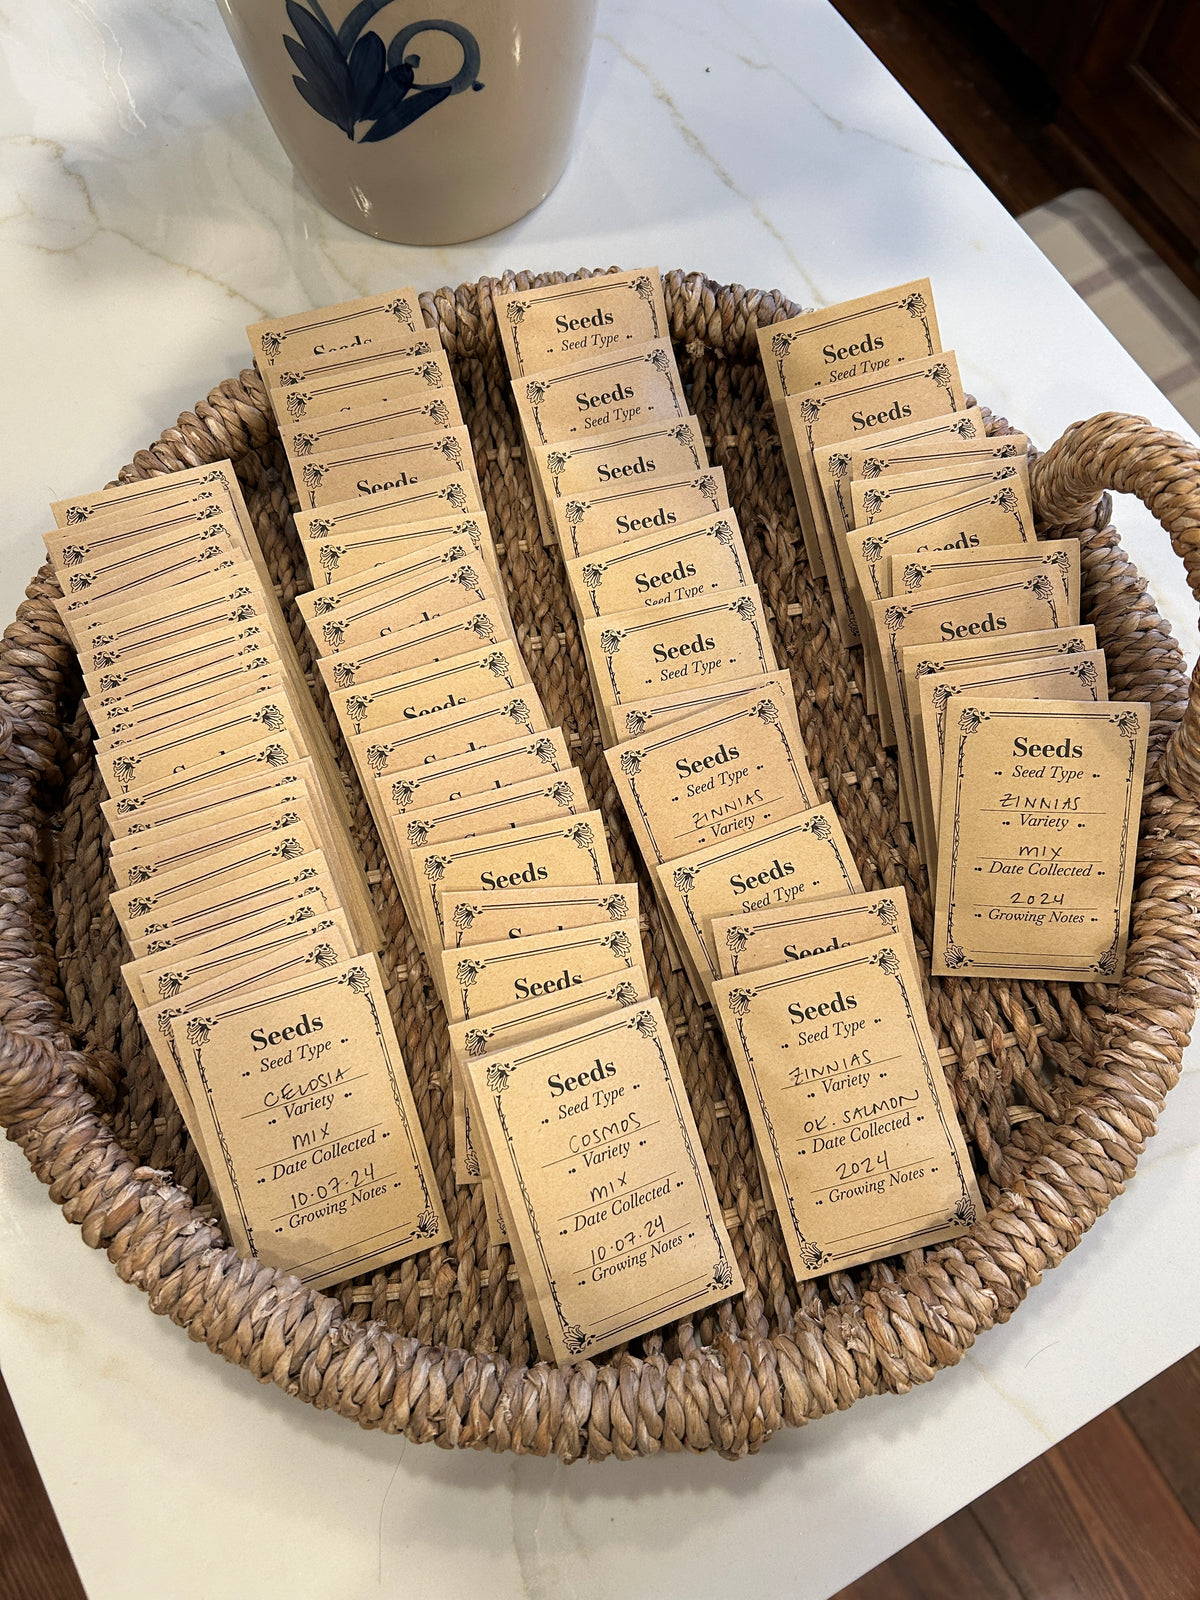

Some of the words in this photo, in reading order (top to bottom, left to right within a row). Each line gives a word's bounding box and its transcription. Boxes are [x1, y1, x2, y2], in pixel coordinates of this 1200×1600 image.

[556, 308, 614, 333] Seeds
[561, 336, 587, 351] Seed
[590, 333, 619, 348] Type
[822, 333, 884, 365] Seeds
[829, 364, 857, 383] Seed
[860, 358, 890, 374] Type
[576, 383, 634, 411] Seeds
[584, 413, 610, 429] Seed
[612, 405, 641, 423] Type
[852, 401, 912, 431] Seeds
[597, 456, 656, 482] Seeds
[616, 508, 676, 534] Seeds
[917, 531, 980, 553] eds
[635, 561, 696, 593] Seeds
[675, 584, 704, 600] Type
[940, 612, 1007, 641] Seeds
[653, 634, 716, 663] Seeds
[660, 664, 688, 681] Seed
[692, 657, 722, 675] Type
[675, 744, 740, 779] Seeds
[1012, 736, 1083, 758] Seeds
[686, 777, 715, 797] Seed
[718, 767, 749, 787] Type
[1012, 765, 1046, 778] Seed
[1050, 766, 1084, 783] Type
[692, 789, 764, 829] ZINNIAS
[1000, 793, 1081, 811] ZINNIAS
[710, 815, 755, 837] Variety
[1020, 814, 1069, 831] Variety
[480, 862, 548, 890] Seeds
[730, 859, 795, 895] Seeds
[988, 861, 1024, 875] Date
[1028, 863, 1093, 877] Collected
[742, 893, 771, 913] Seed
[773, 883, 805, 902] Type
[1010, 892, 1064, 905] 2024
[988, 908, 1046, 925] Growing
[1048, 911, 1085, 924] Notes
[514, 970, 583, 999] Seeds
[788, 991, 857, 1025] Seeds
[250, 1013, 324, 1052] Seeds
[798, 1026, 829, 1046] Seed
[833, 1018, 866, 1039] Type
[260, 1051, 293, 1073] Seed
[297, 1040, 332, 1062] Type
[788, 1049, 872, 1085] ZINNIAS
[263, 1067, 351, 1107] CELOSIA
[547, 1059, 617, 1098] Seeds
[821, 1070, 870, 1094] Variety
[284, 1092, 335, 1119] Variety
[558, 1101, 589, 1120] Seed
[592, 1085, 625, 1108] Type
[843, 1089, 919, 1124] SALMON
[569, 1112, 641, 1153] COSMOS
[812, 1134, 846, 1153] Date
[850, 1112, 911, 1143] Collected
[272, 1160, 307, 1181] Date
[311, 1129, 376, 1166] Collected
[582, 1140, 631, 1168] Variety
[835, 1150, 890, 1180] 2024
[828, 1178, 885, 1204] Growing
[889, 1168, 924, 1187] Notes
[289, 1200, 347, 1229] Growing
[351, 1183, 387, 1207] Notes
[574, 1210, 608, 1232] Date
[611, 1179, 671, 1216] Collected
[591, 1251, 648, 1282] Growing
[650, 1235, 683, 1259] Notes
